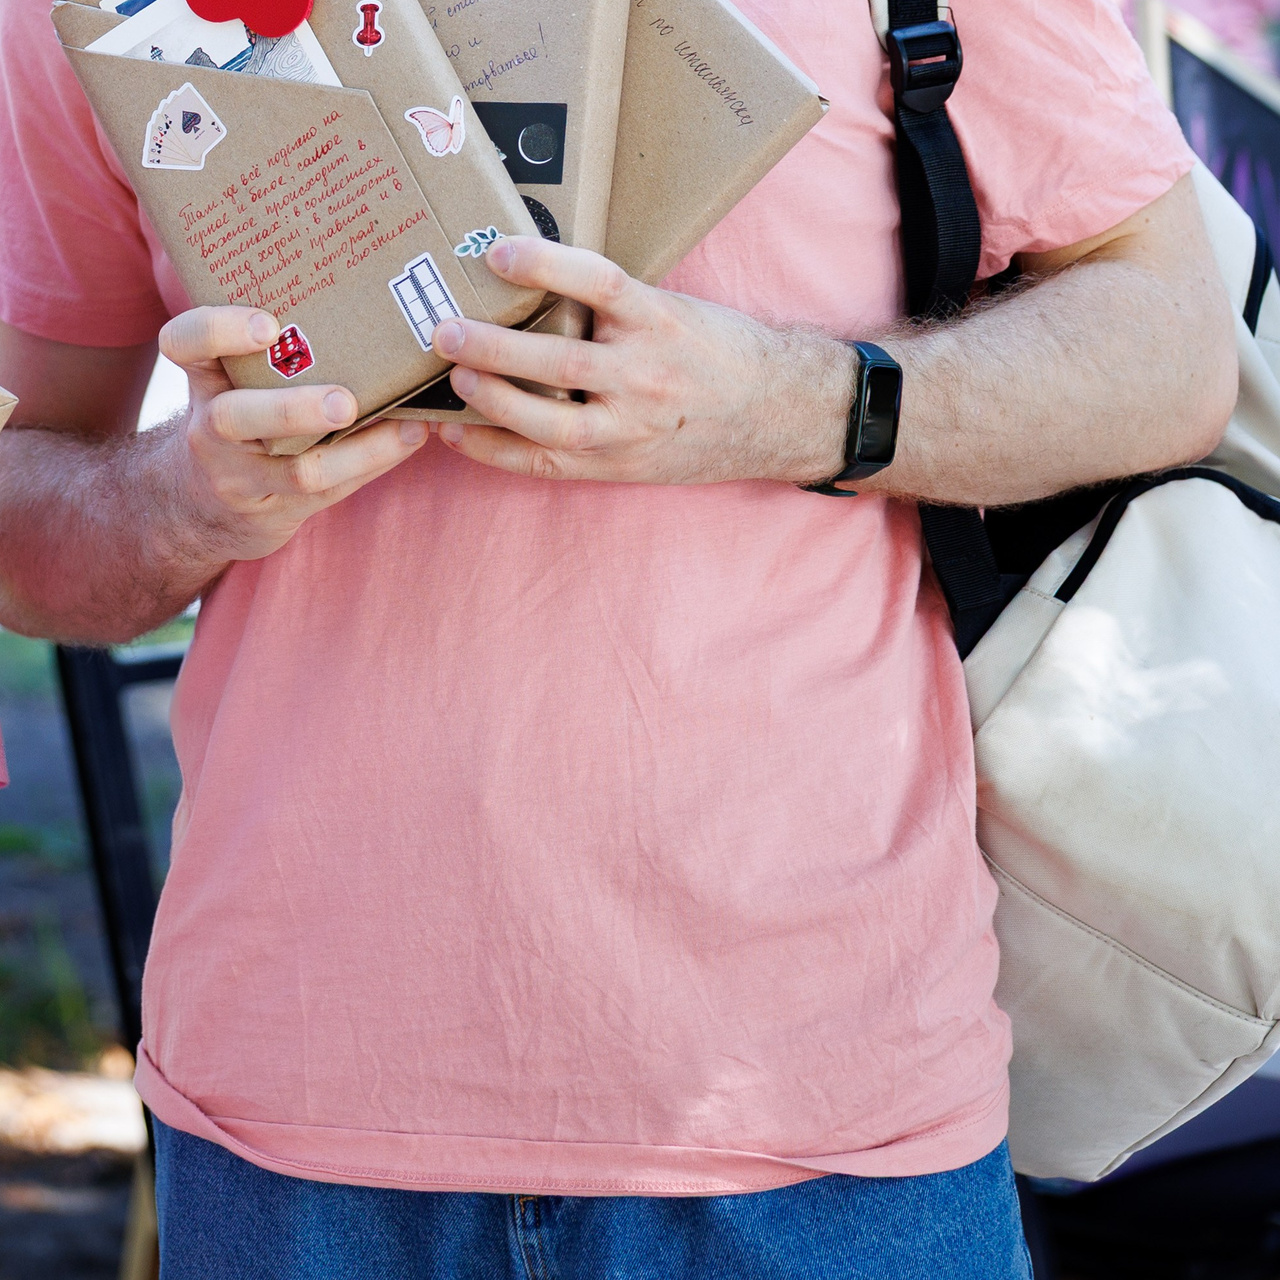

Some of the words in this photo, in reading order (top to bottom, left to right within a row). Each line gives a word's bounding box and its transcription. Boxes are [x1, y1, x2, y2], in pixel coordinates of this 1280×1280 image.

[649, 18, 674, 36] по
[240, 163, 261, 186] всё
[267, 126, 318, 168] поделено
[322, 110, 343, 127] на
[200, 217, 257, 259] важное
[265, 153, 349, 217] происходит
[357, 139, 367, 151] в
[236, 203, 247, 214] и
[293, 205, 301, 218] в
[304, 156, 383, 211] сомнениях
[217, 260, 257, 286] перед
[312, 212, 321, 225] в
[327, 166, 398, 216] смелости
[227, 249, 303, 305] нарушить
[309, 203, 370, 252] правила
[379, 190, 389, 201] и
[392, 178, 403, 192] в
[273, 272, 336, 318] новится
[346, 208, 429, 269] союзником
[314, 221, 375, 272] которая
